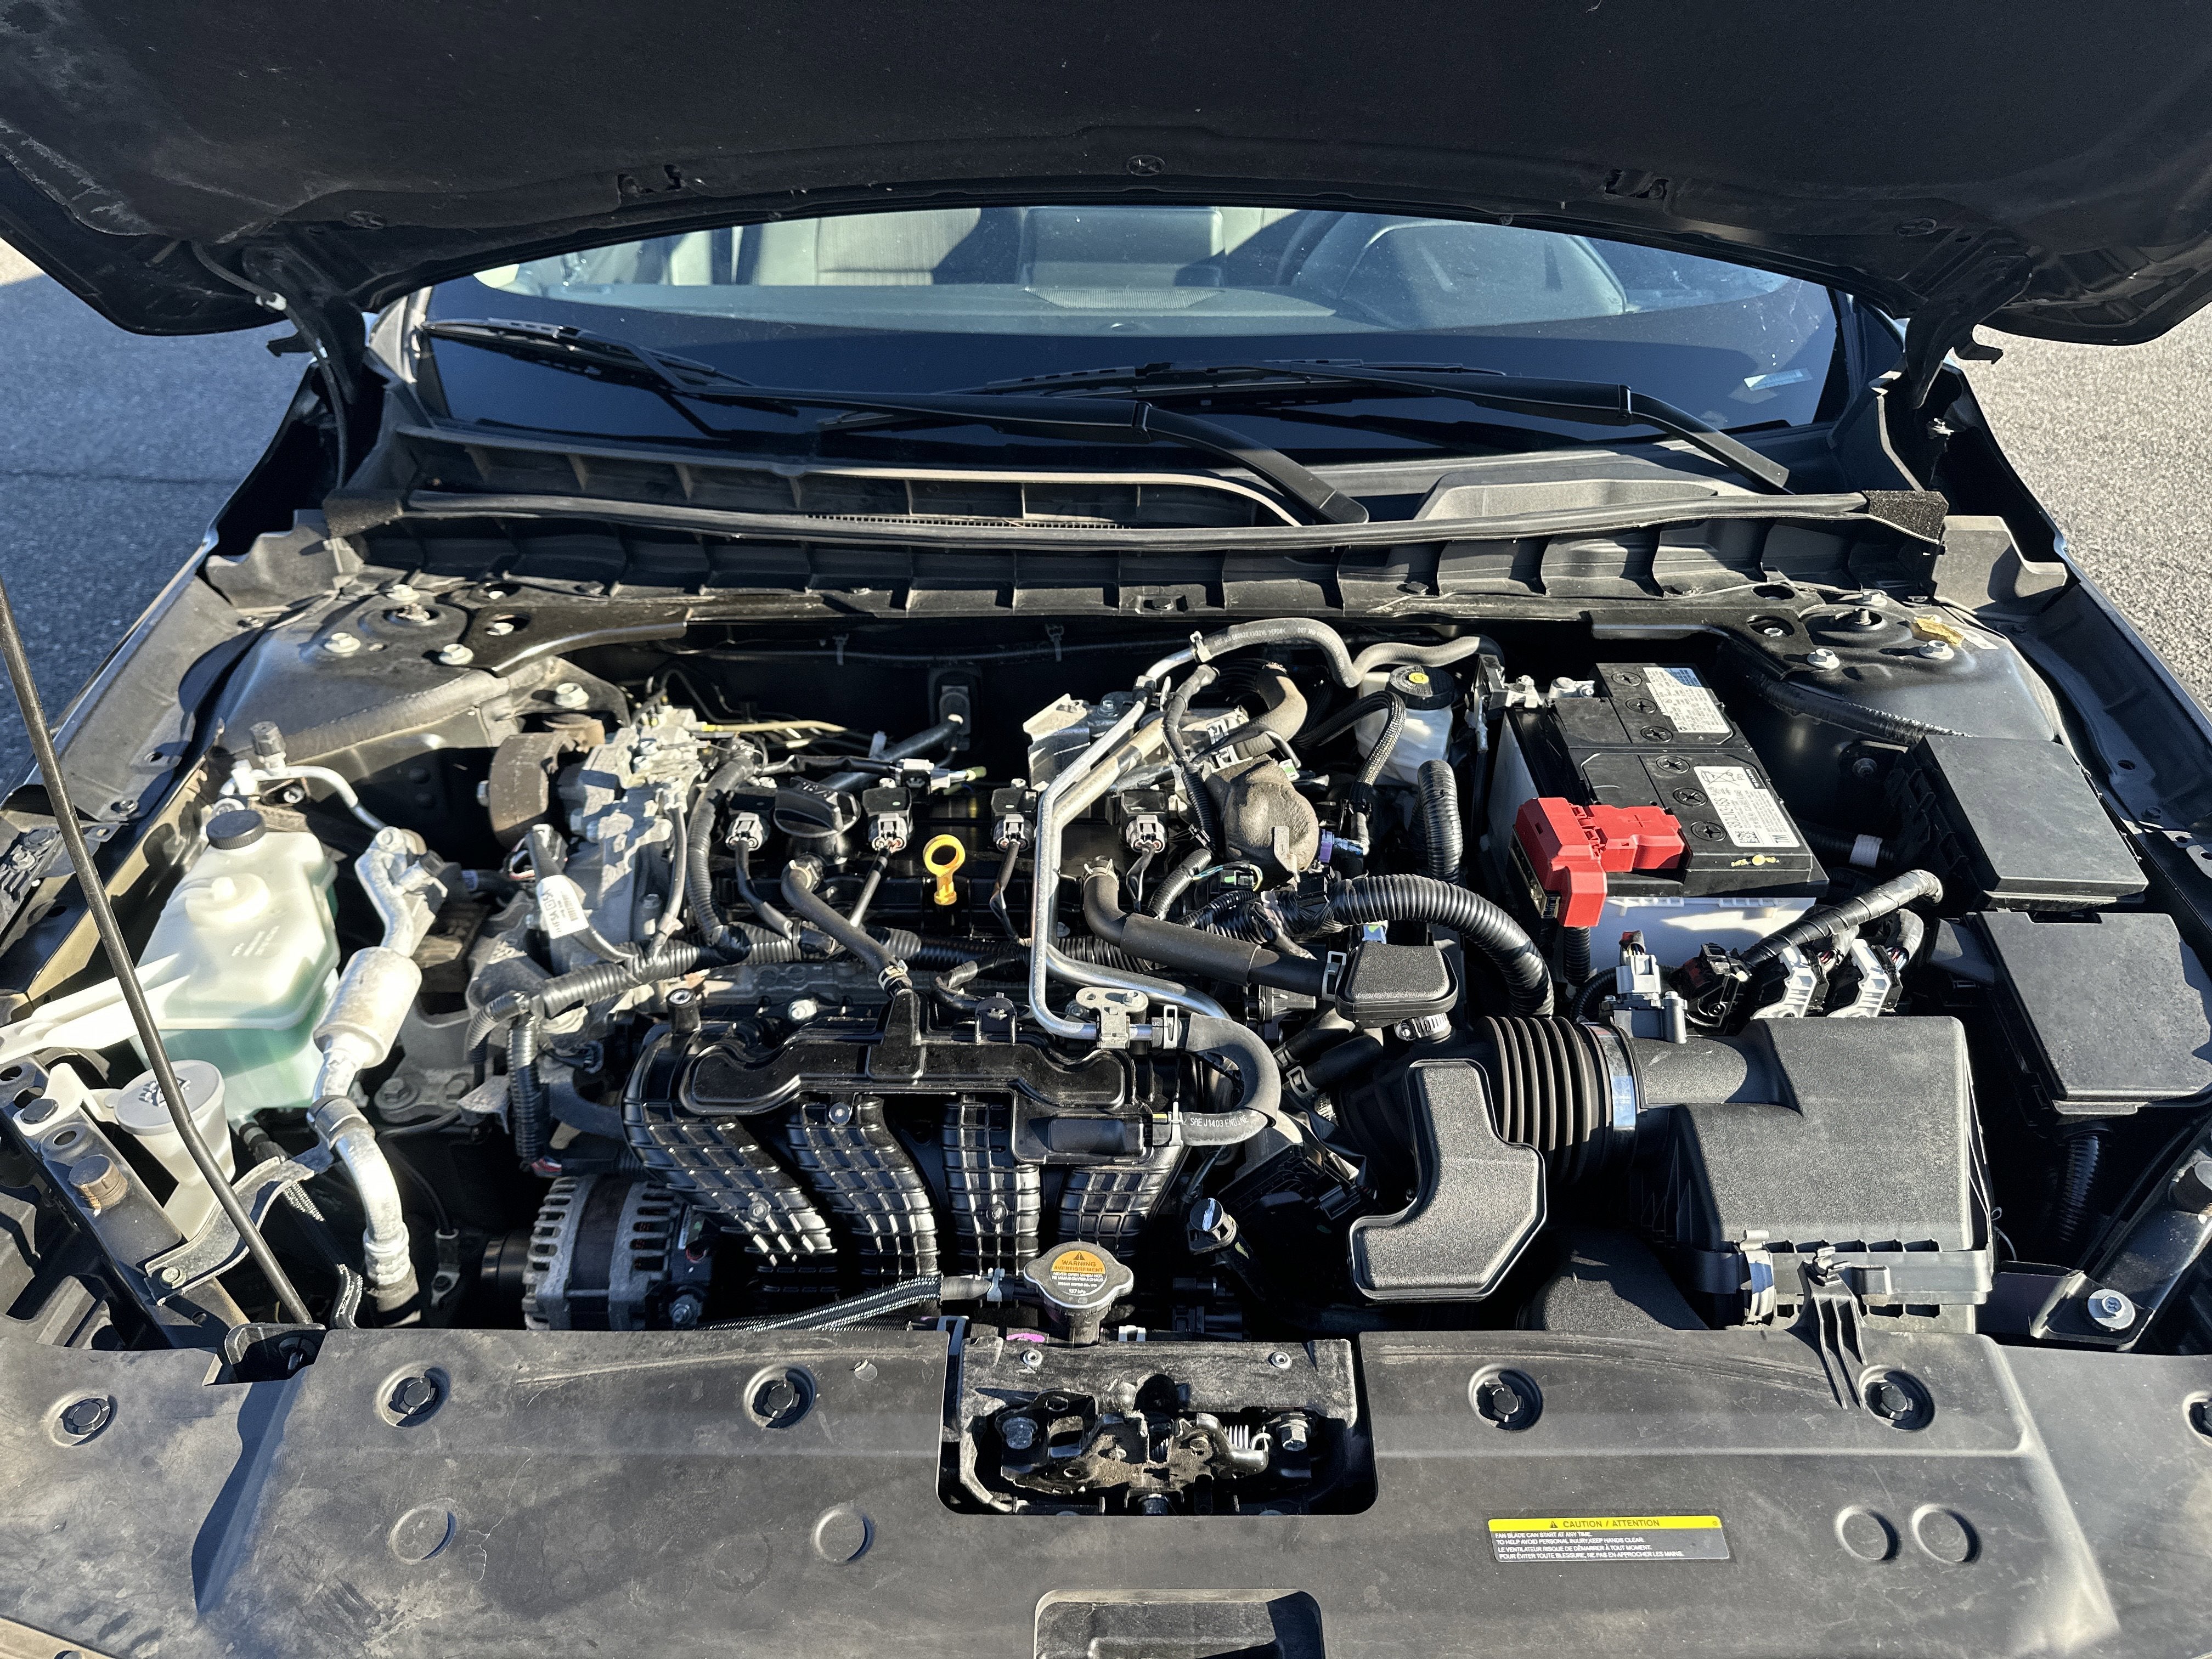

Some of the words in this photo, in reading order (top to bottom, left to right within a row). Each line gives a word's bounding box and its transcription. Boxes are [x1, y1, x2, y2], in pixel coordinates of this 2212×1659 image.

[1190, 1117, 1203, 1127] SAE
[1204, 1119, 1224, 1128] J1403
[1225, 1115, 1249, 1127] ENGINE
